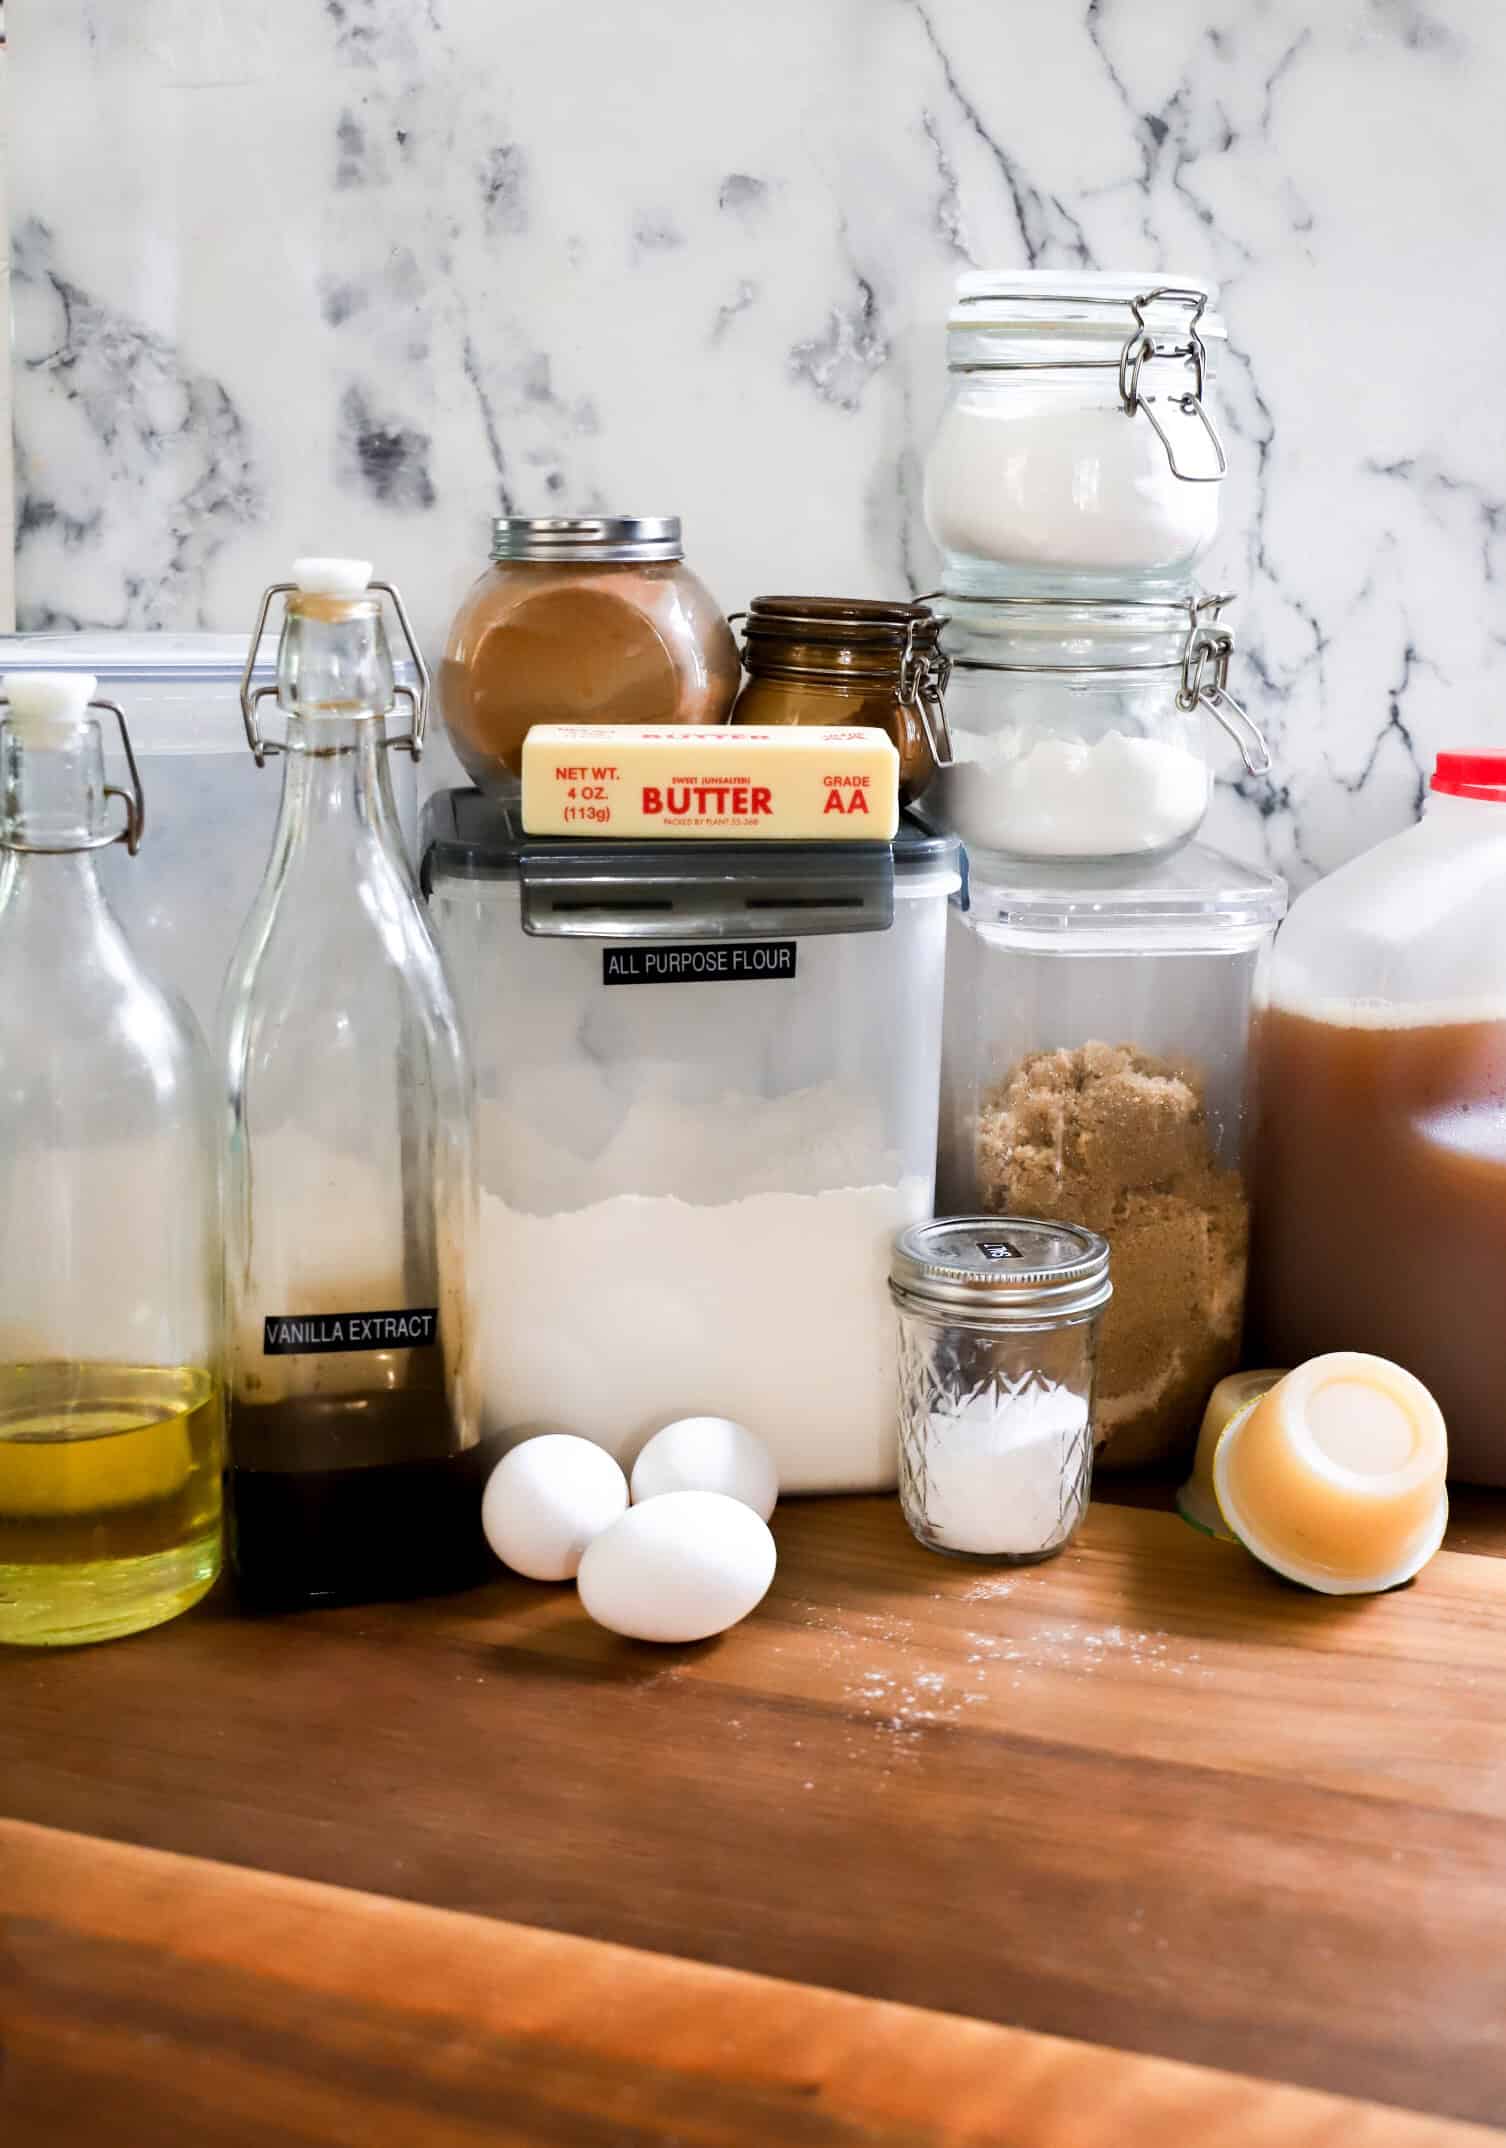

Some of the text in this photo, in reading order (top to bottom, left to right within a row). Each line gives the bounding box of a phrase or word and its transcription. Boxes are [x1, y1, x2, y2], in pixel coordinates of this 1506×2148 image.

[555, 767, 620, 781] NET WT.
[671, 776, 698, 785] SWEET
[823, 776, 871, 788] GRADE
[567, 787, 609, 800] 4 OZ.
[642, 786, 774, 815] BUTTER
[823, 789, 869, 814] AA
[563, 806, 611, 823] (113g)
[608, 948, 791, 975] ALL PURPOSE FLOUR
[266, 1315, 433, 1345] VANILLA EXTRACT
